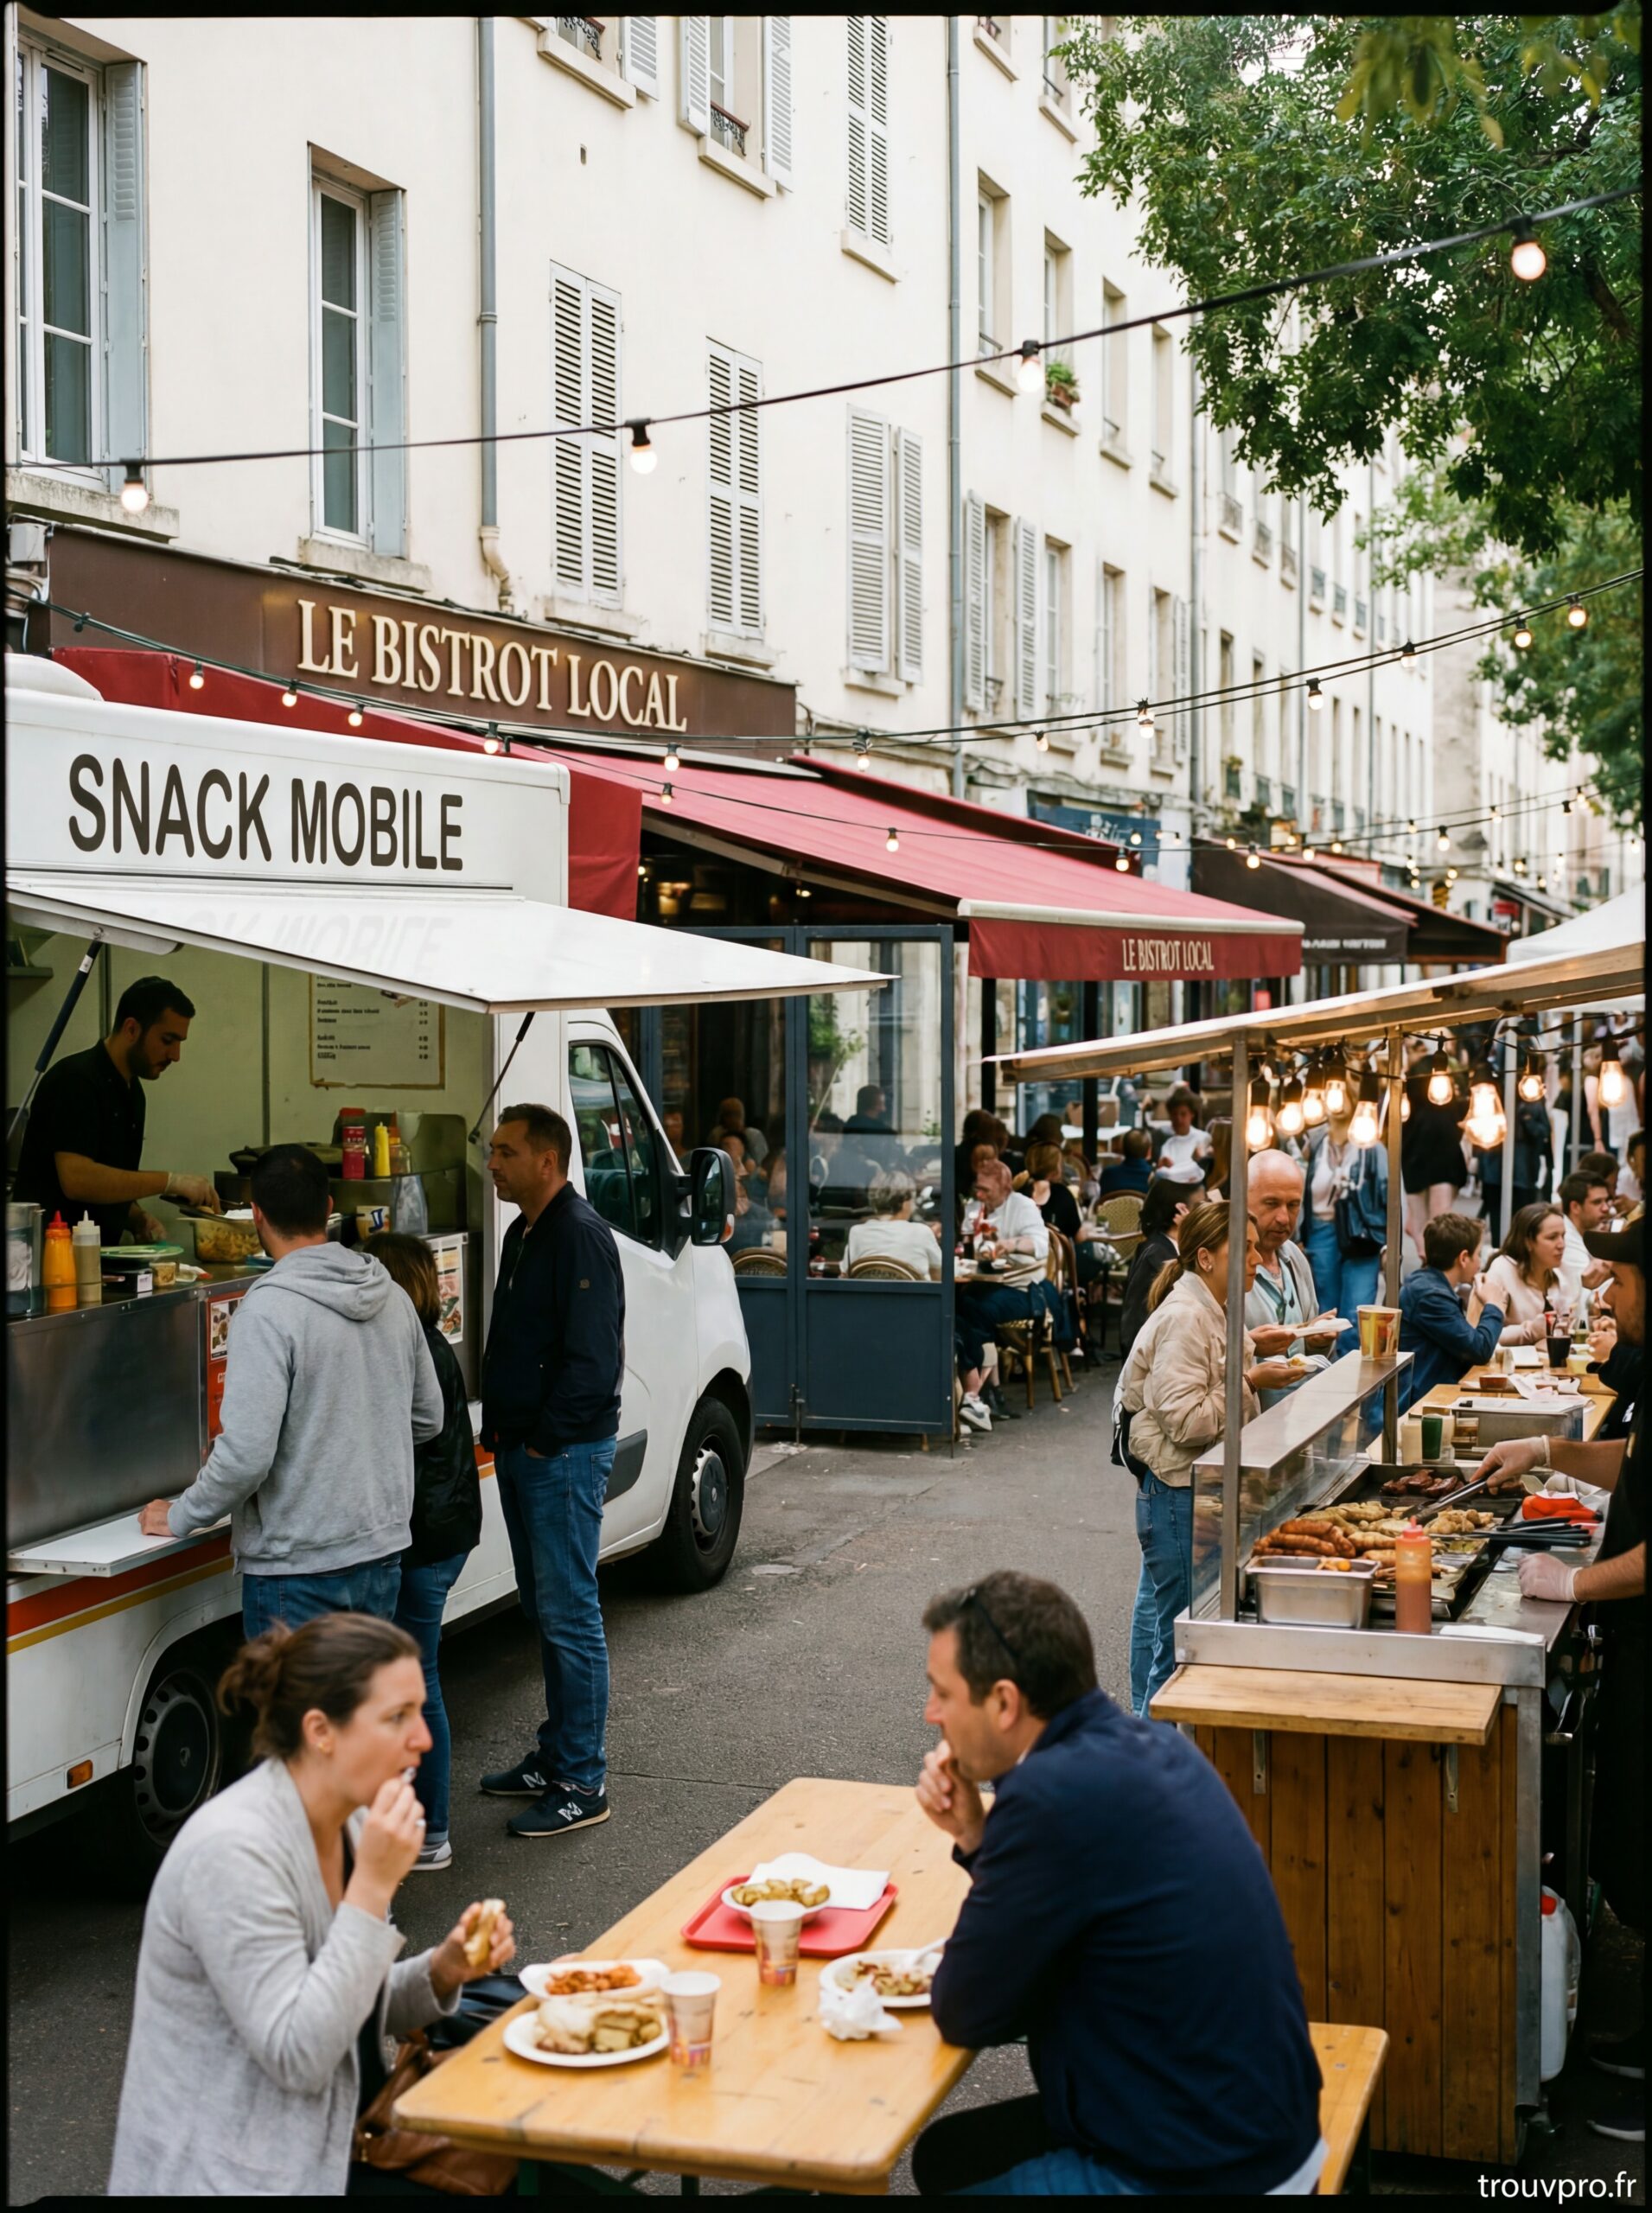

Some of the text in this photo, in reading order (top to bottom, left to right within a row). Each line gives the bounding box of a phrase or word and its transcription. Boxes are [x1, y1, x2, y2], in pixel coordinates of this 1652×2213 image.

[297, 599, 688, 733] LE BISTROT LOCAL
[68, 754, 463, 871] SNACK MOBILE
[1122, 939, 1215, 972] LE BISTROT LOCAL
